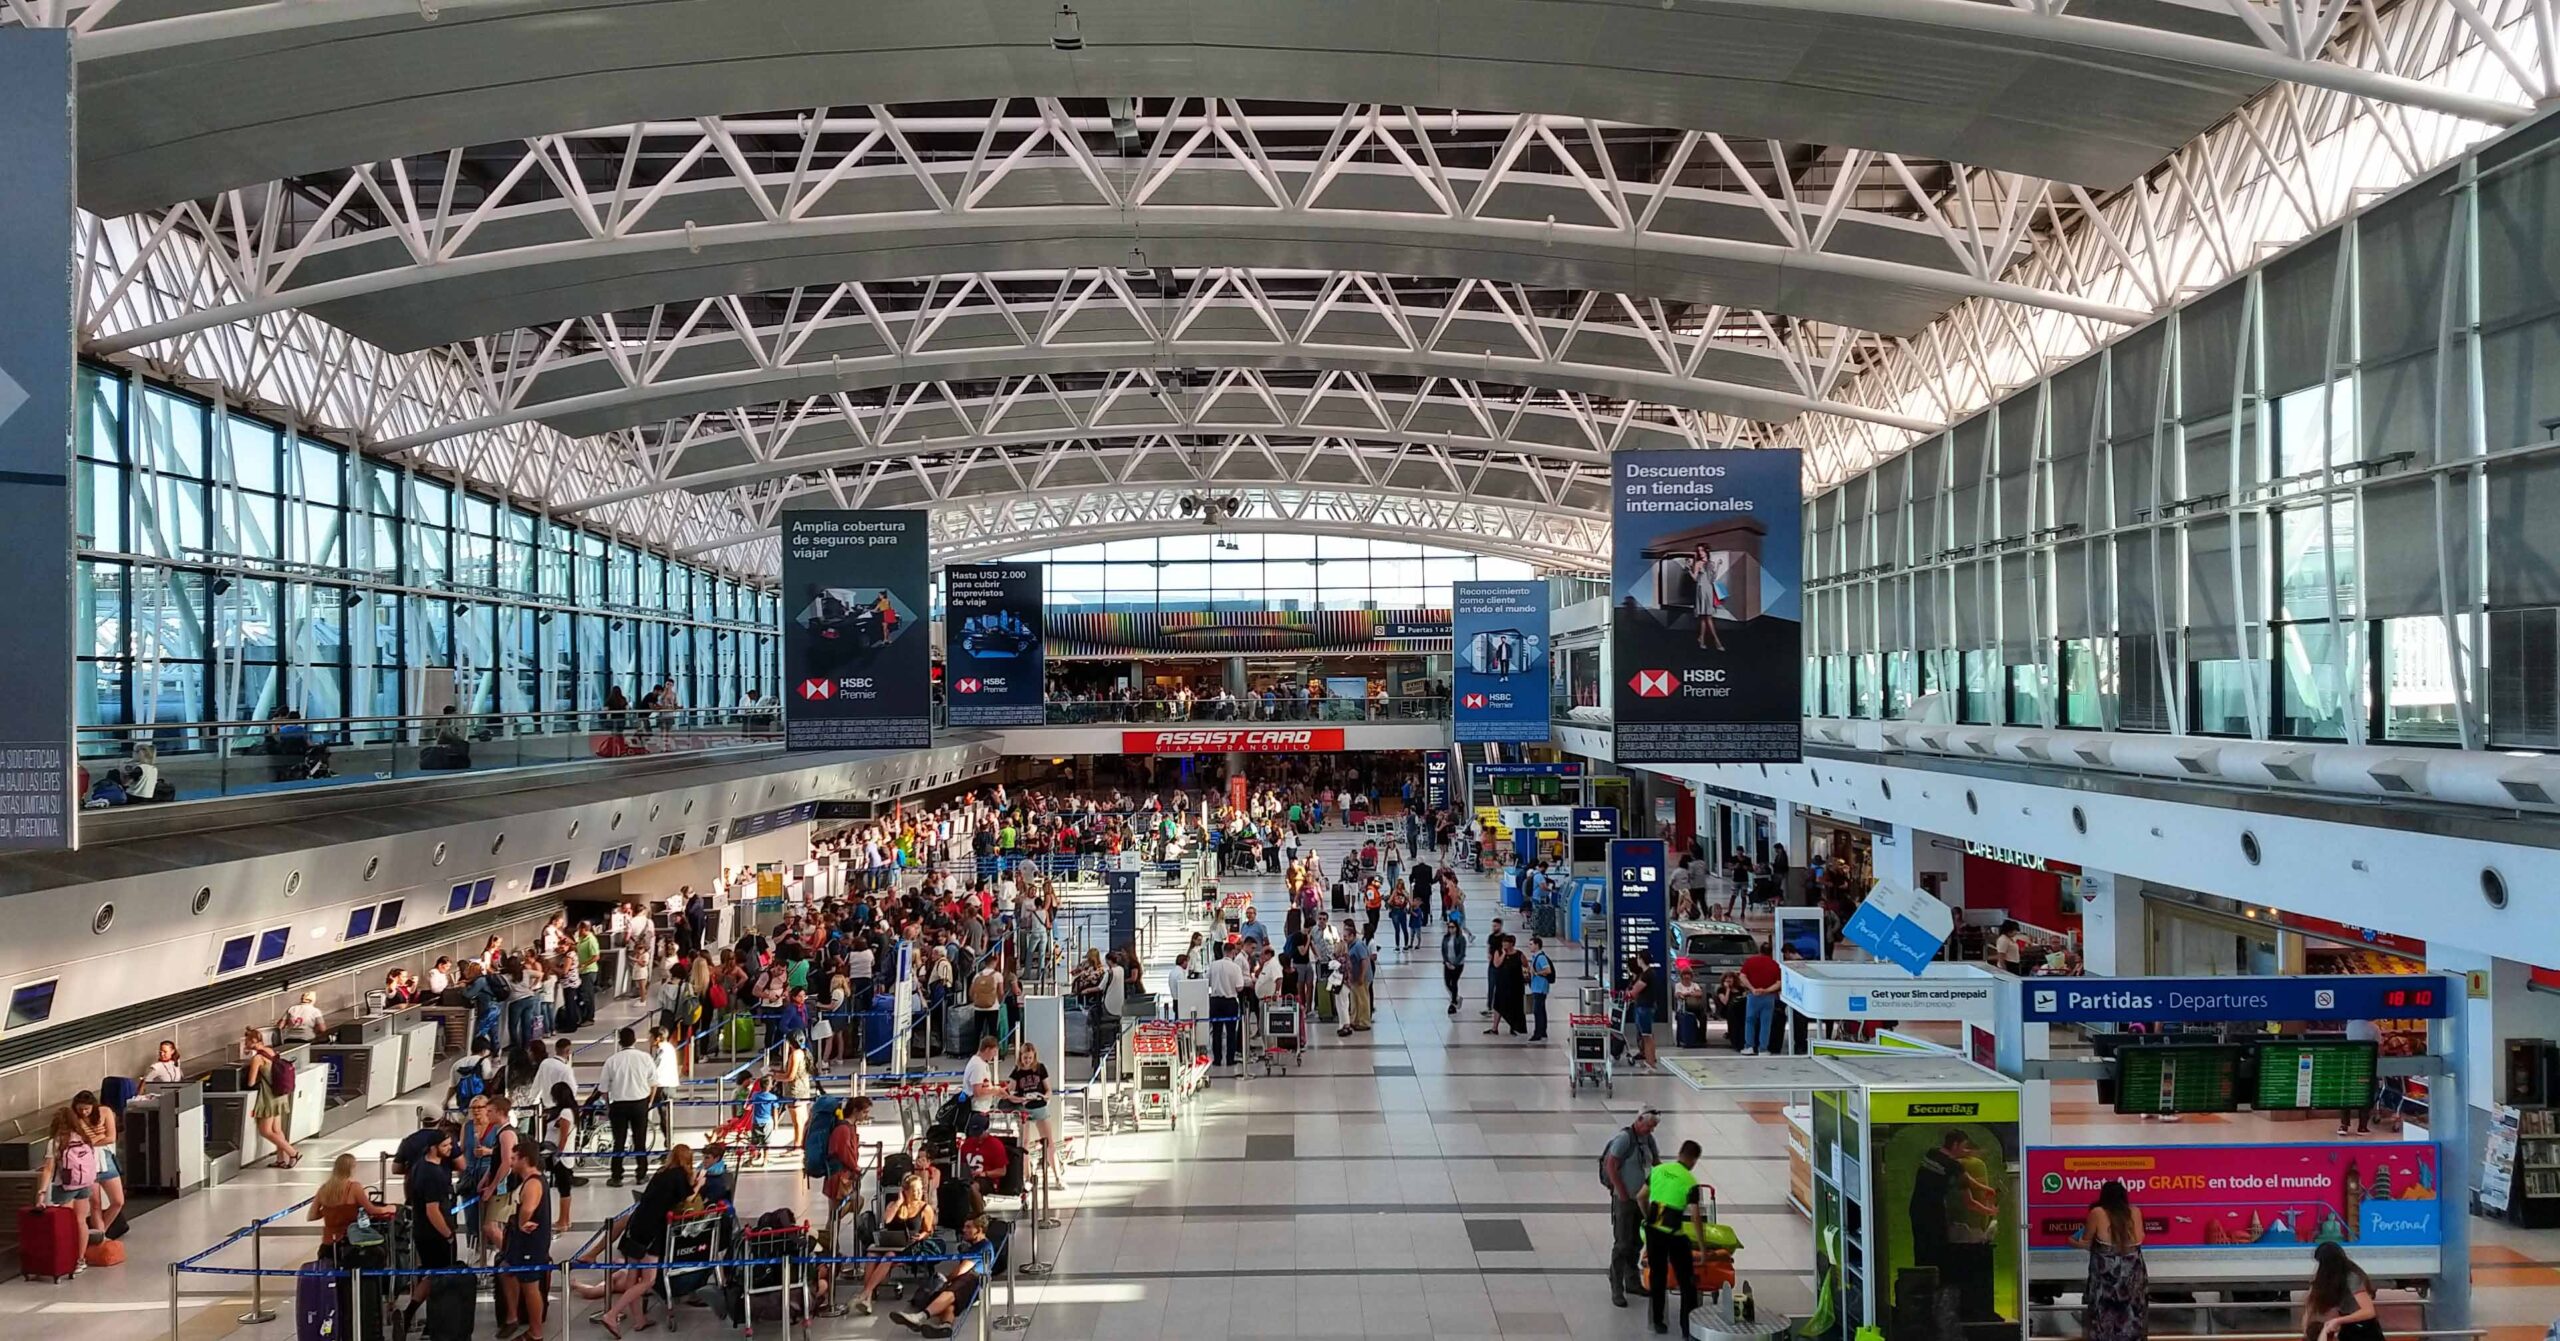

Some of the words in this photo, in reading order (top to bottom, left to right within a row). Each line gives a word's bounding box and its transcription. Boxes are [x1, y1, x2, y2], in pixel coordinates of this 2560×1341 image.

[1626, 464, 1726, 478] Descuentos
[1626, 484, 1647, 495] en
[1651, 481, 1714, 495] tiendas
[1626, 498, 1754, 512] internacionales
[792, 521, 840, 534] Amplia
[843, 521, 906, 532] cobertura
[792, 534, 810, 546] de
[812, 535, 866, 549] seguros
[868, 536, 898, 548] para
[792, 547, 829, 561] viajar
[952, 571, 977, 580] Hasta
[979, 571, 1000, 580] USD
[1001, 570, 1027, 580] 2.000
[952, 581, 973, 590] para
[974, 579, 1001, 589] cubrir
[952, 589, 1004, 600] imprevistos
[1459, 587, 1530, 596] Reconocimiento
[952, 598, 964, 607] de
[965, 598, 987, 608] viaje
[1486, 595, 1516, 604] cliente
[1472, 605, 1493, 613] todo
[1495, 604, 1504, 613] el
[1505, 604, 1536, 613] mundo
[1408, 626, 1433, 634] Puertas
[983, 677, 1006, 686] HSBC
[1683, 669, 1726, 683] HSBC
[840, 677, 873, 689] HSBC
[983, 685, 1009, 693] Premier
[840, 688, 877, 700] Premier
[1489, 693, 1512, 701] HSBC
[1683, 684, 1732, 698] Premier
[1489, 701, 1514, 709] Premier
[1155, 731, 1246, 745] ASSIST
[1246, 731, 1312, 744] CARD
[1155, 744, 1204, 752] VIAJA
[1216, 743, 1311, 751] TRANQUILO
[6, 749, 23, 769] SIDO
[24, 749, 60, 769] RETOCADA
[6, 772, 24, 792] BAJO
[26, 772, 39, 792] LAS
[40, 772, 60, 792] LEYES
[21, 795, 49, 815] LIMITAN
[50, 794, 60, 815] SU
[15, 818, 60, 837] ARGENTINA.
[2015, 850, 2046, 872] FLOR
[1622, 885, 1649, 893] Arribos
[1888, 930, 1926, 960] Personal
[1871, 989, 1889, 999] Get
[1890, 990, 1911, 1000] your
[1911, 989, 1928, 999] Sim
[1929, 989, 1950, 999] card
[1950, 989, 1987, 1000] prepaid
[2388, 991, 2405, 1007] 18
[2415, 990, 2432, 1006] 10
[2068, 992, 2153, 1010] Partidas
[2169, 992, 2268, 1012] Departures
[1912, 1104, 1977, 1115] SecureBag
[2066, 1176, 2146, 1192] WhatApp
[2149, 1175, 2206, 1190] GRATIS
[2208, 1178, 2227, 1189] en
[2229, 1174, 2263, 1190] todo
[2265, 1174, 2281, 1189] el
[2283, 1174, 2332, 1189] mundo
[2371, 1212, 2431, 1234] Personal
